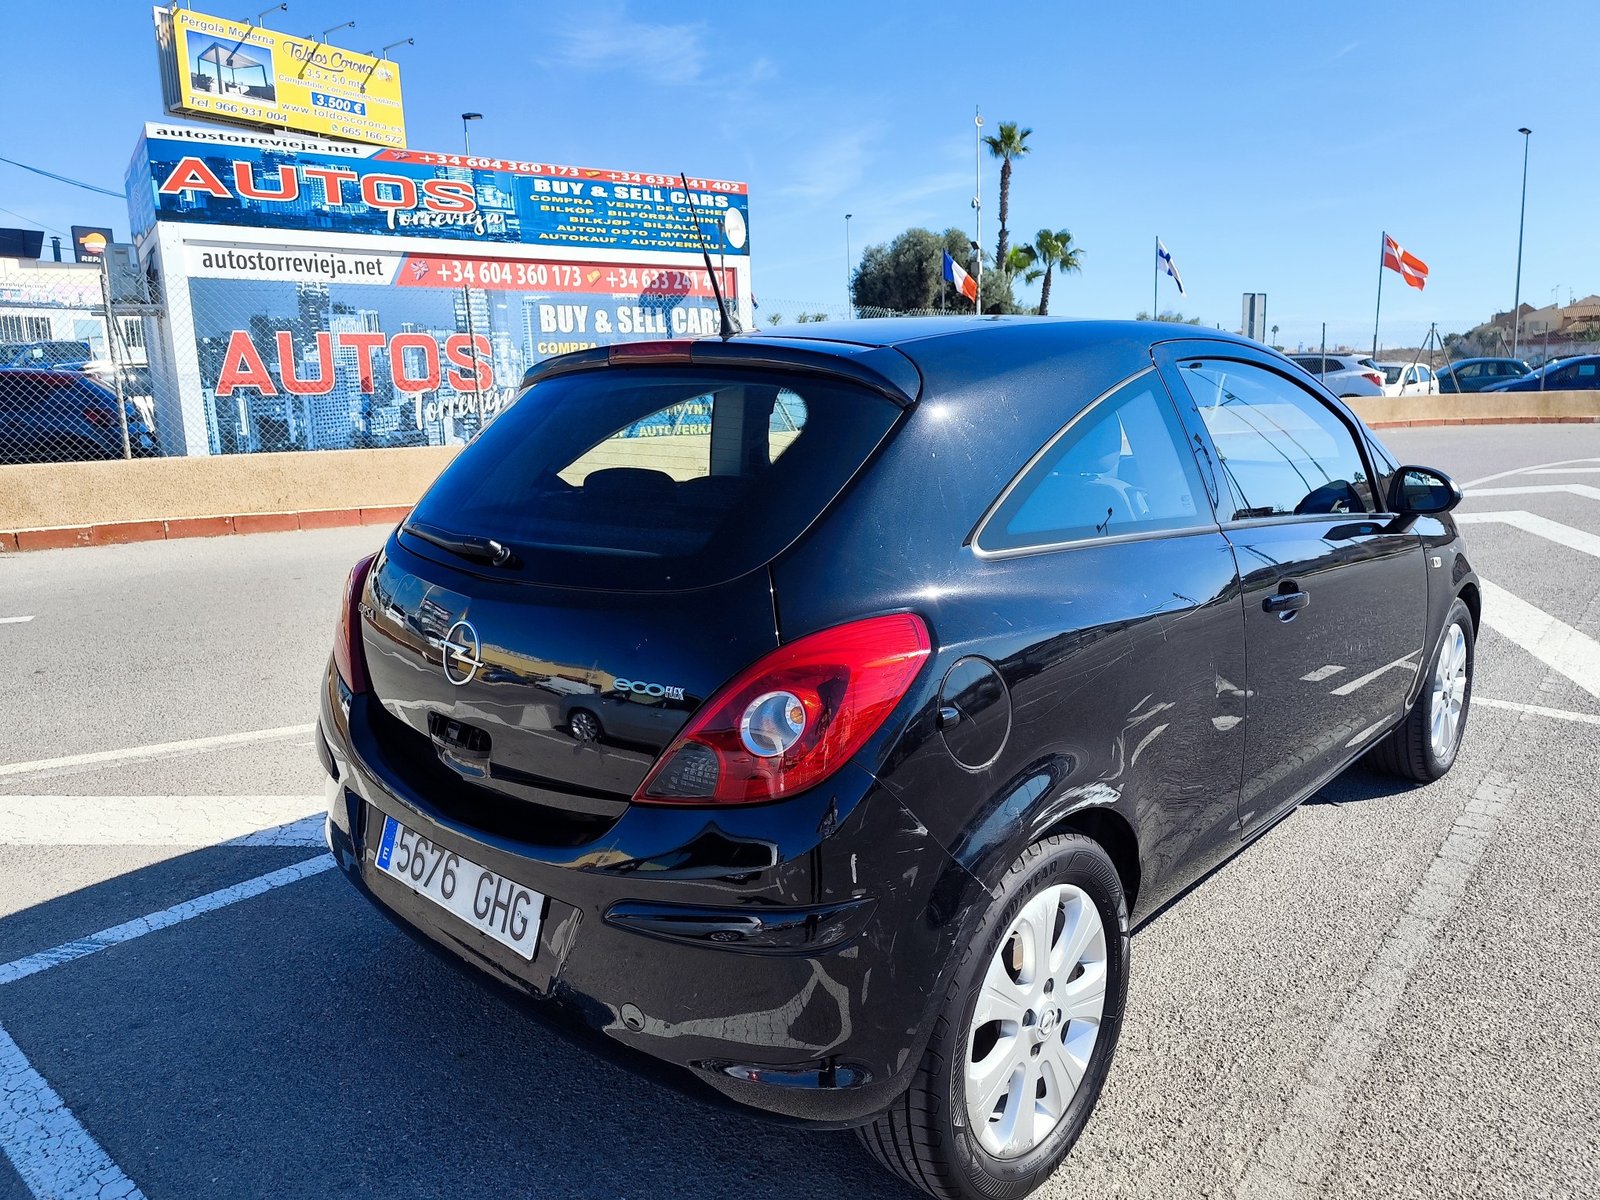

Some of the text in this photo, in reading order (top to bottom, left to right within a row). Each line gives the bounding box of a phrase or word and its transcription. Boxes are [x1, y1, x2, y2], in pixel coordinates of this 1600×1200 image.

[229, 27, 275, 45] Moderna
[283, 41, 374, 75] Toldos Corona
[278, 74, 324, 90] Compatible
[327, 85, 341, 94] con
[190, 96, 287, 122] Tel. 966 931 004
[316, 94, 363, 114] 3.500 €
[156, 127, 360, 154] autostorrevieja.net
[341, 126, 403, 144] 665 166 572
[419, 155, 579, 177] +34 604 360 173
[159, 156, 478, 214] AUTOS
[607, 172, 740, 192] +34 633 241 402
[529, 194, 593, 205] COMPRA
[606, 200, 652, 210] VENTA
[533, 179, 728, 208] BUY & SELL CARS
[540, 204, 594, 214] BILKÖP
[383, 207, 502, 235] Torrevieja
[569, 216, 631, 226] BILKJØP
[539, 233, 617, 243] AUTOKAUF
[556, 225, 606, 234] AUTON
[611, 229, 648, 237] OSTO
[660, 232, 711, 241] MYYNTI
[202, 251, 384, 279] autostorrevieja.net
[437, 261, 582, 287] +34 604 360 173
[606, 268, 638, 288] +34
[641, 269, 669, 289] 633
[673, 270, 699, 290] 241
[539, 304, 589, 334] BUY
[595, 310, 612, 333] &
[617, 306, 668, 334] SELL
[215, 330, 493, 396] AUTOS
[382, 847, 389, 860] E
[397, 826, 531, 941] 5676 GHG
